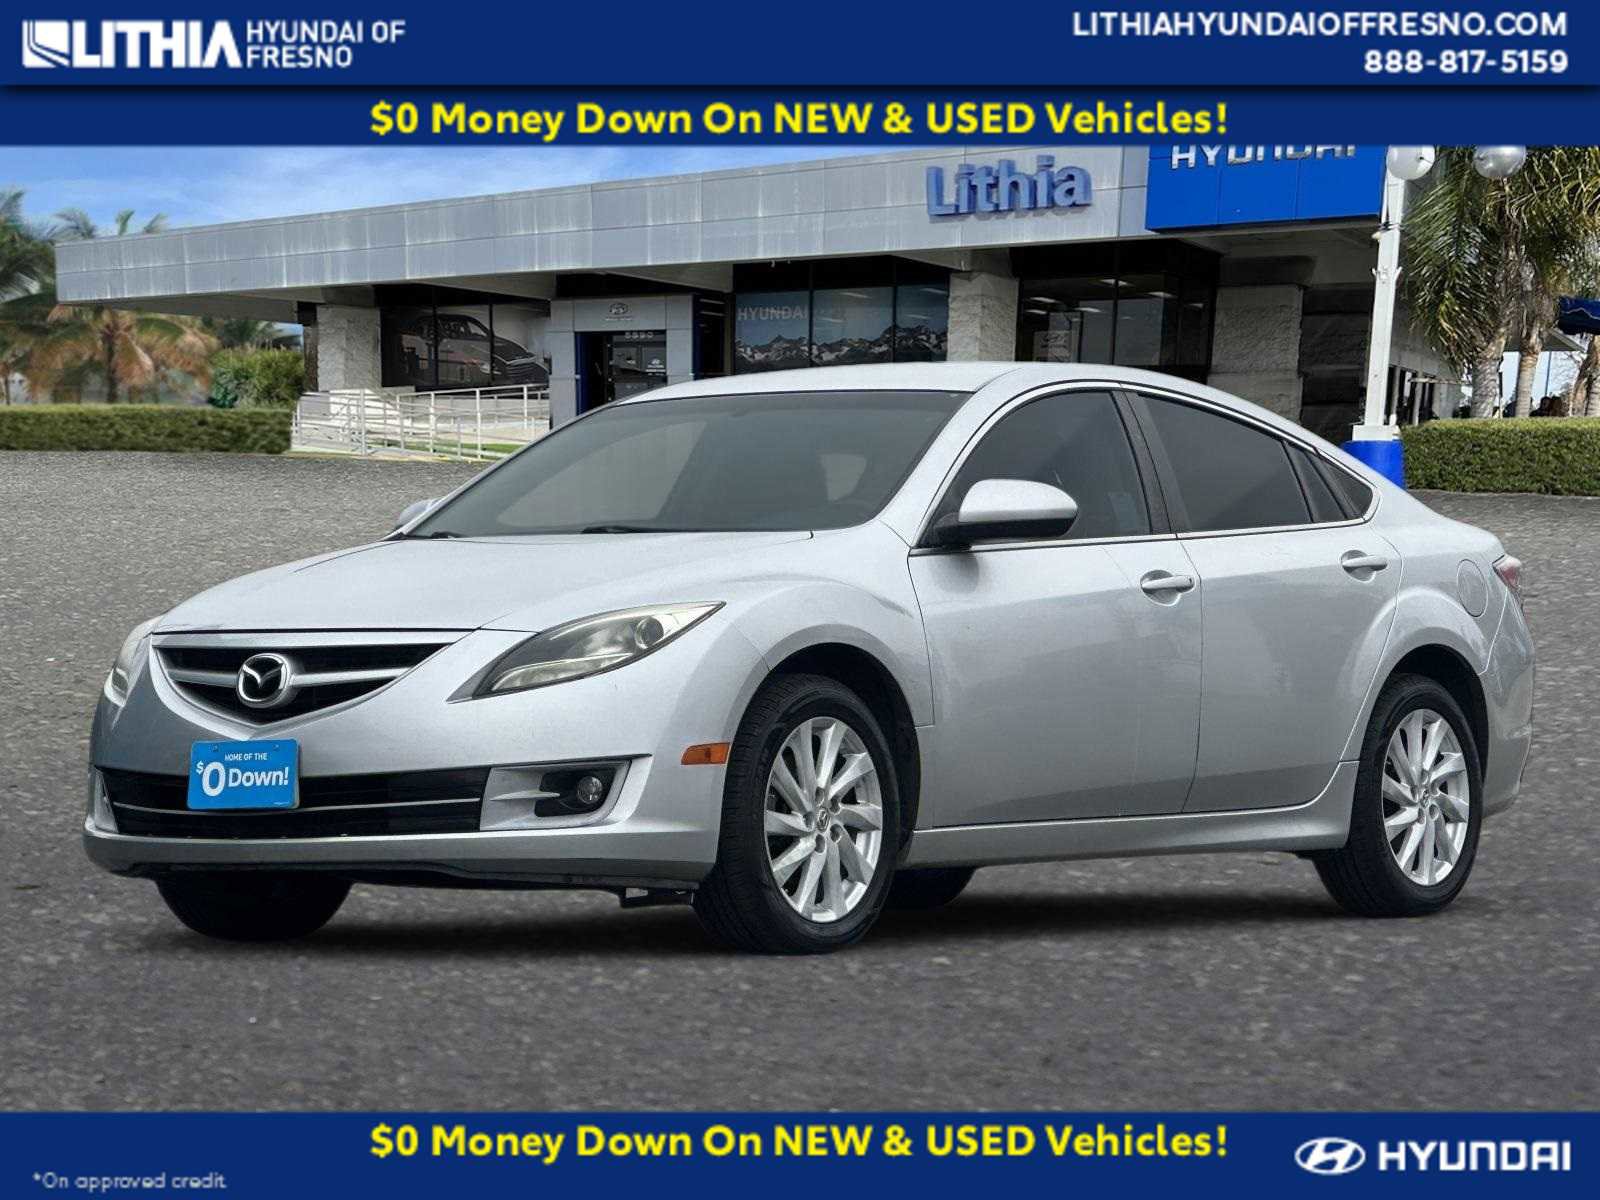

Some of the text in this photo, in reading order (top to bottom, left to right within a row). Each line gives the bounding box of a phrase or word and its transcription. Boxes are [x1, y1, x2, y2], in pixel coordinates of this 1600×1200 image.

[926, 154, 1092, 216] Lithia
[737, 305, 808, 320] HYUNDAI
[254, 752, 268, 761] THE
[228, 767, 289, 787] Down!
